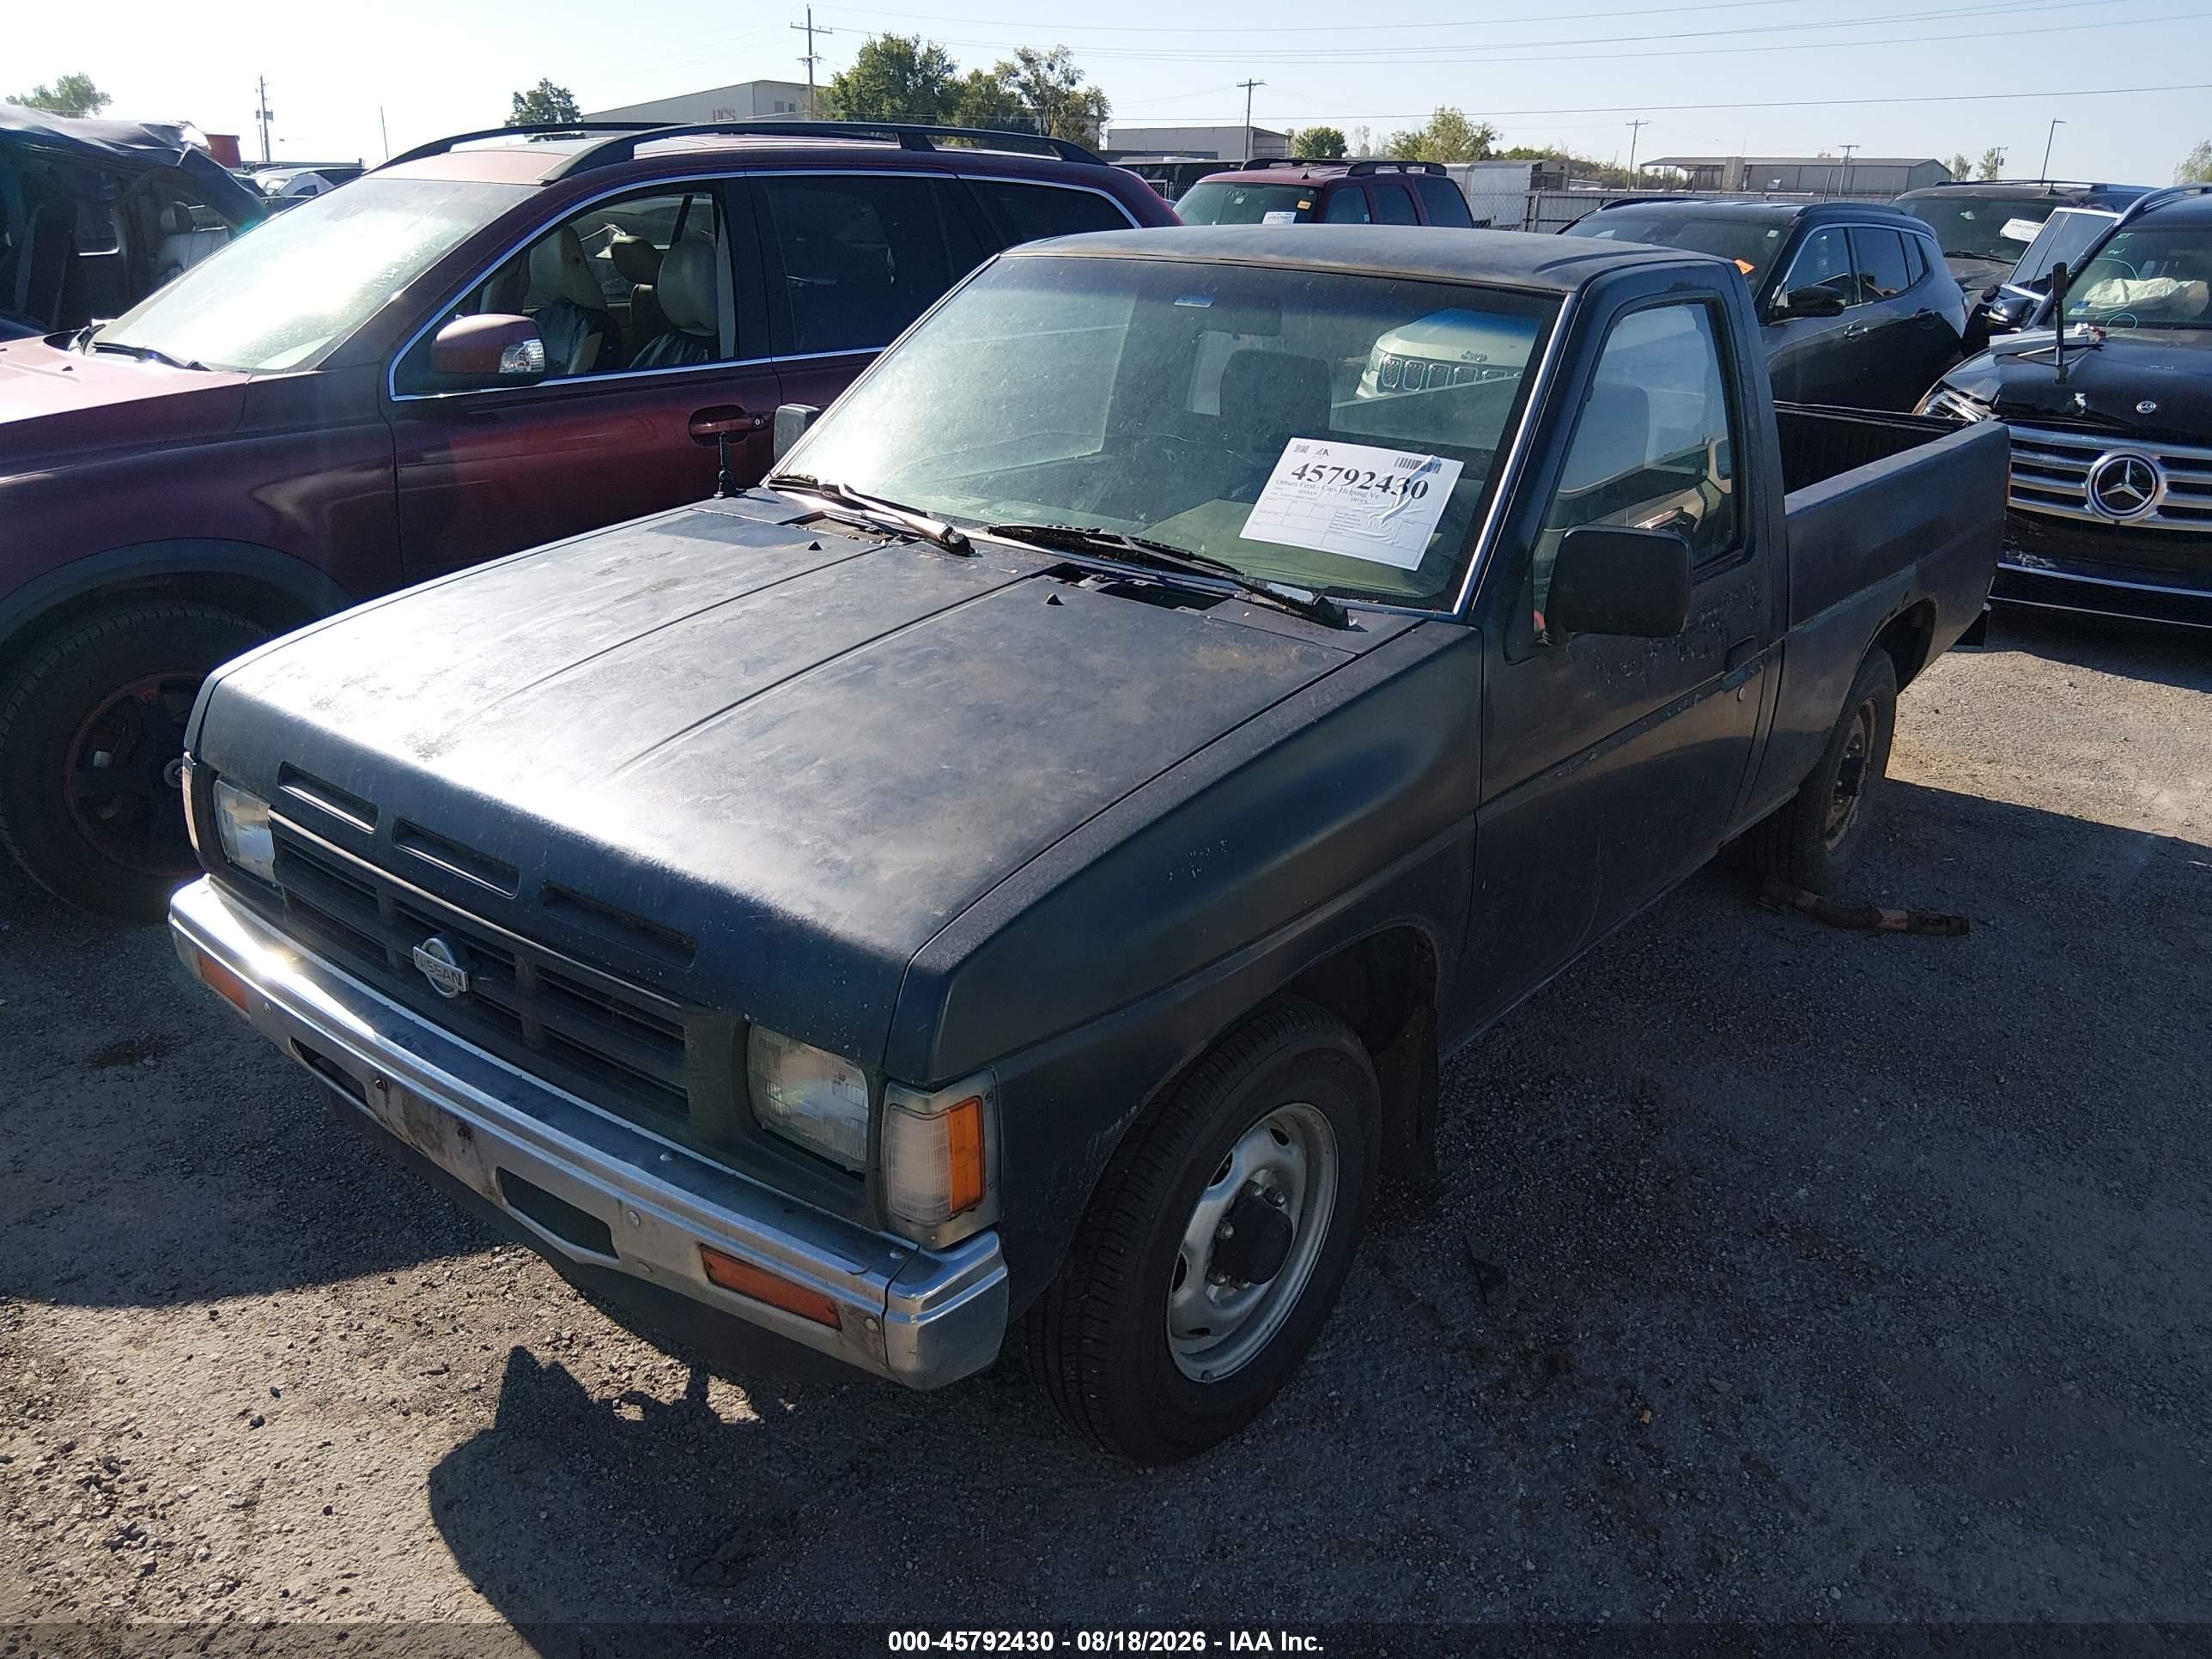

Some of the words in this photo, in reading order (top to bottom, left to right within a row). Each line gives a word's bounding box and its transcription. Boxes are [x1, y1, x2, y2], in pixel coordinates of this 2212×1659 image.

[1291, 463, 1429, 500] 45792430
[1299, 480, 1316, 489] First
[1322, 484, 1337, 493] Cars
[1337, 486, 1368, 499] Helping
[415, 951, 461, 987] NISSAN
